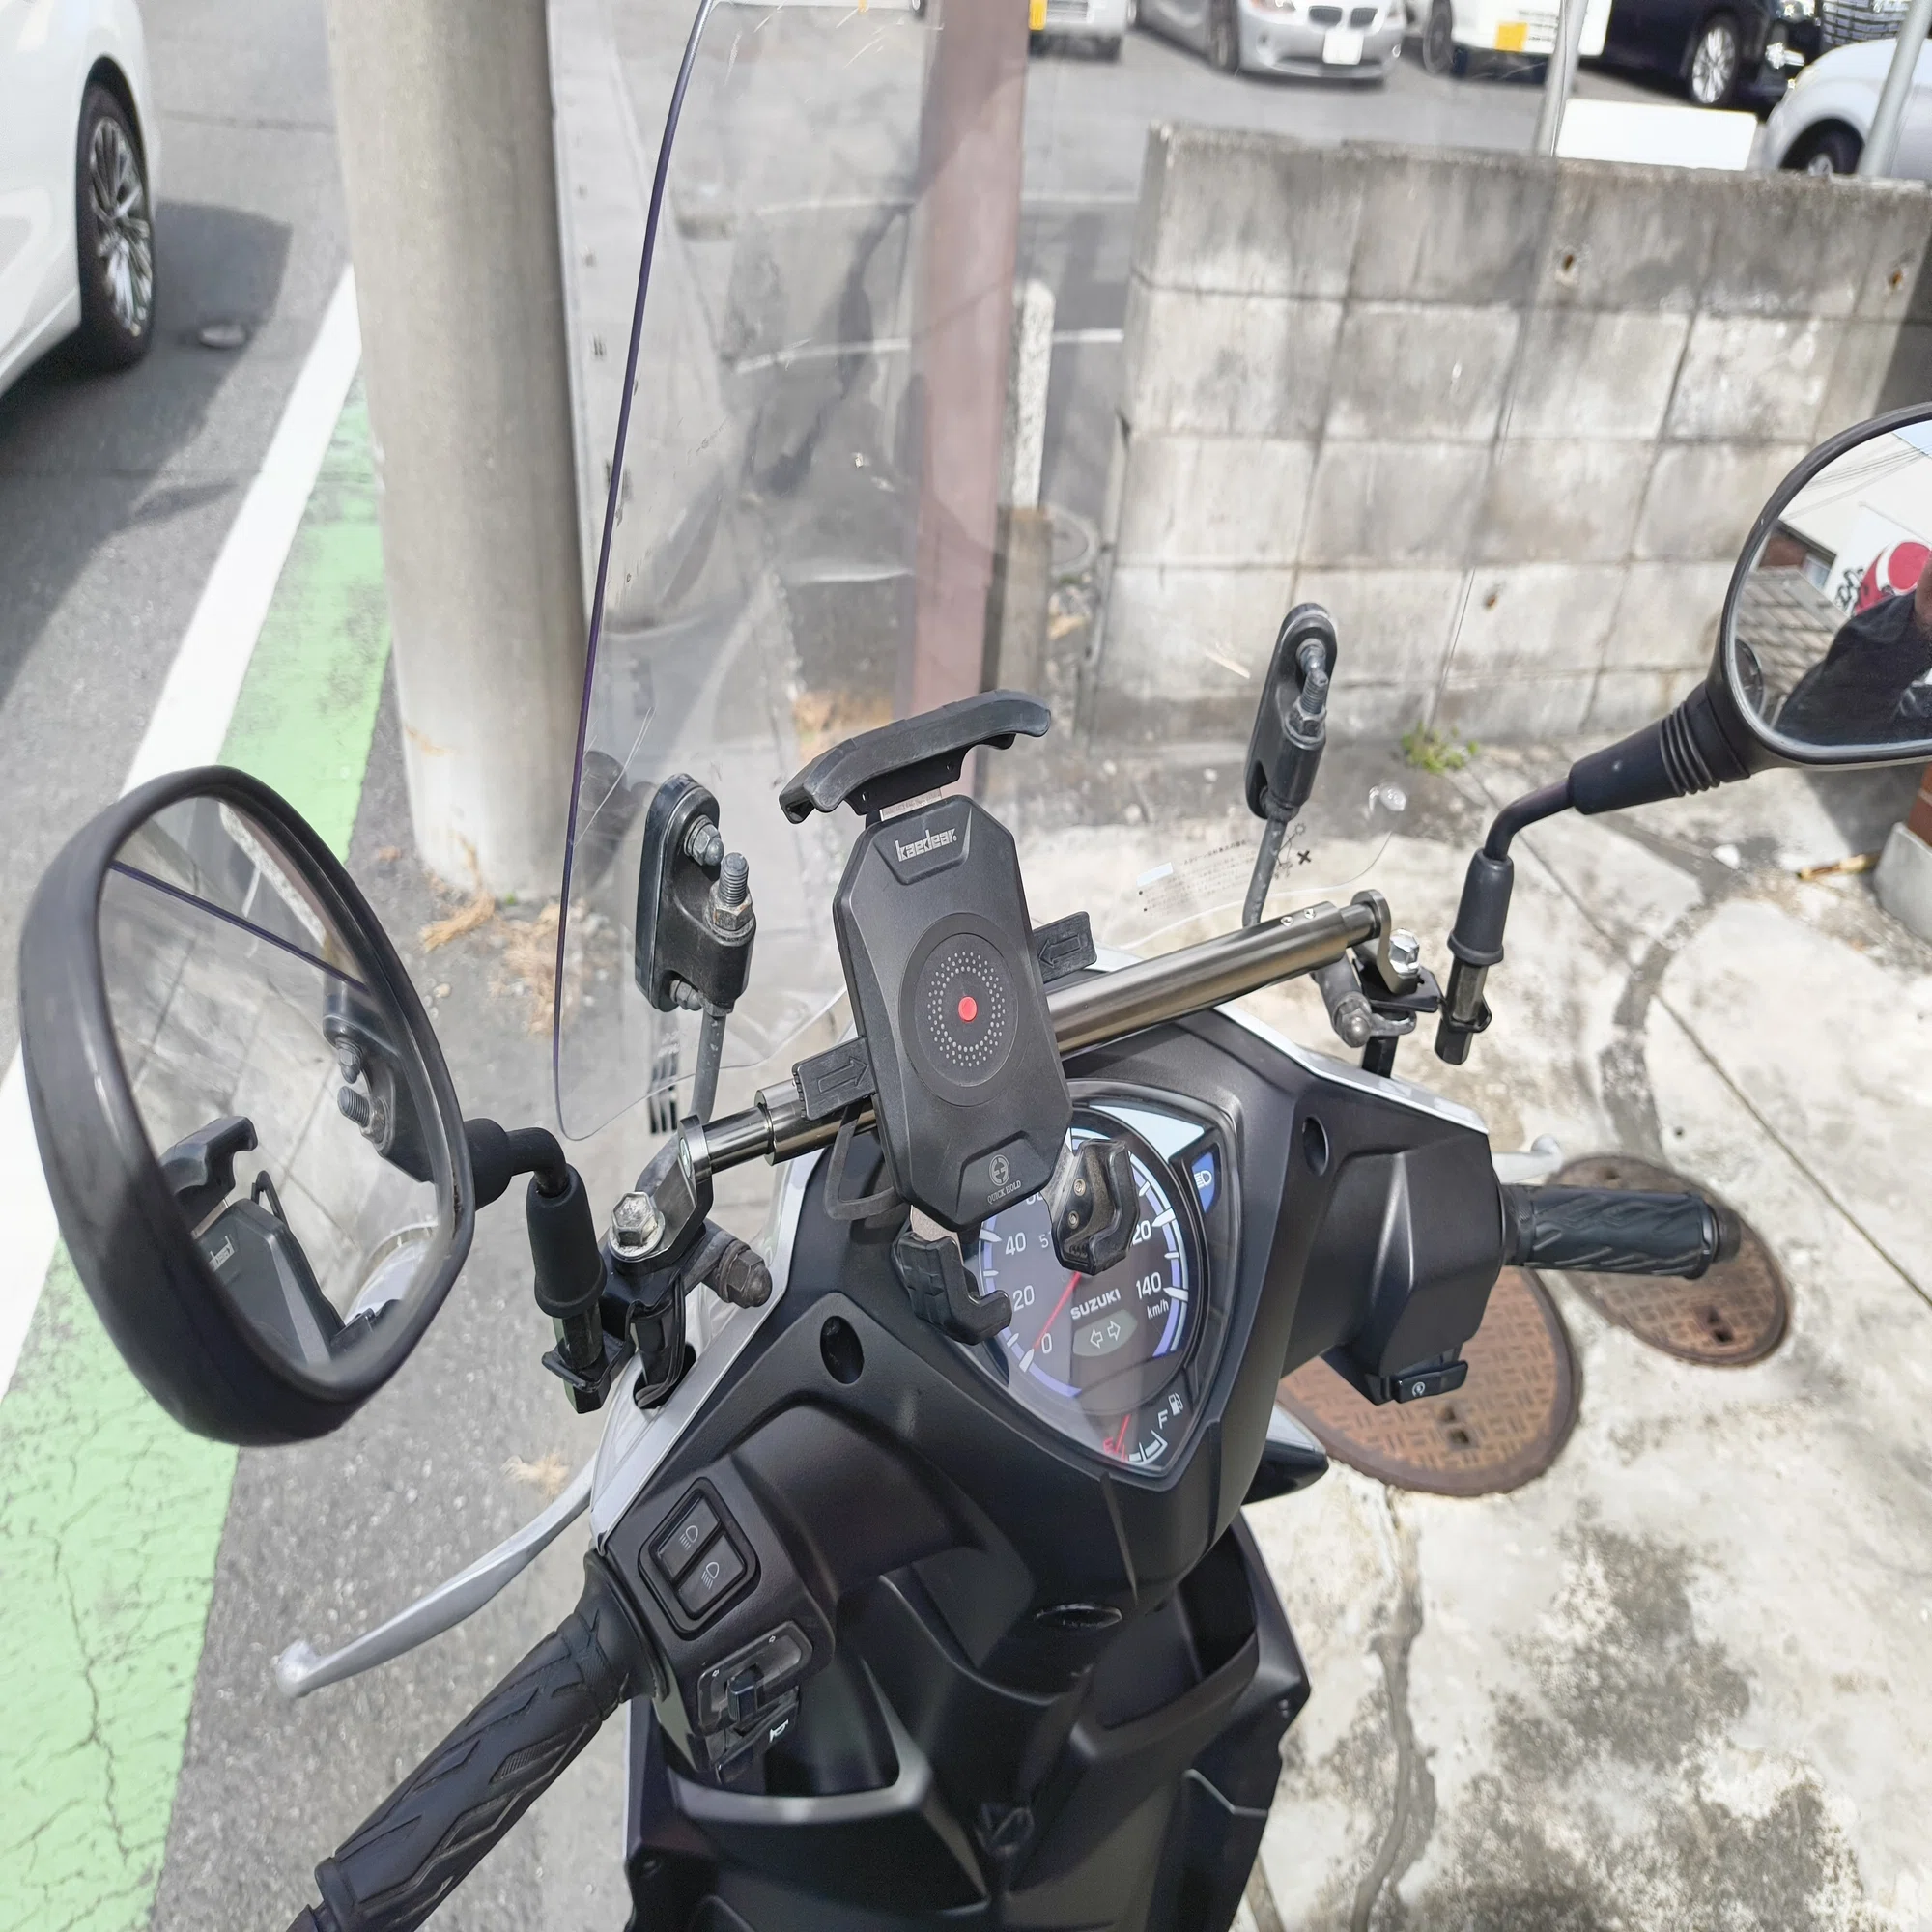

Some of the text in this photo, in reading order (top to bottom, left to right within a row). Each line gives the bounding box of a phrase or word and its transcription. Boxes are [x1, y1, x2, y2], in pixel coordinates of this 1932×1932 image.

[895, 828, 956, 862] kaedear
[987, 1187, 1007, 1205] QUICK
[1006, 1179, 1022, 1195] HOLD
[1005, 1232, 1027, 1256] 40
[1130, 1220, 1151, 1247] 20
[1012, 1285, 1036, 1312] 20
[1135, 1271, 1162, 1300] 140
[1070, 1288, 1121, 1320] SUZUKI
[1147, 1298, 1170, 1320] km/h
[1040, 1333, 1053, 1354] 0
[1157, 1409, 1169, 1430] F
[1102, 1436, 1114, 1454] E
